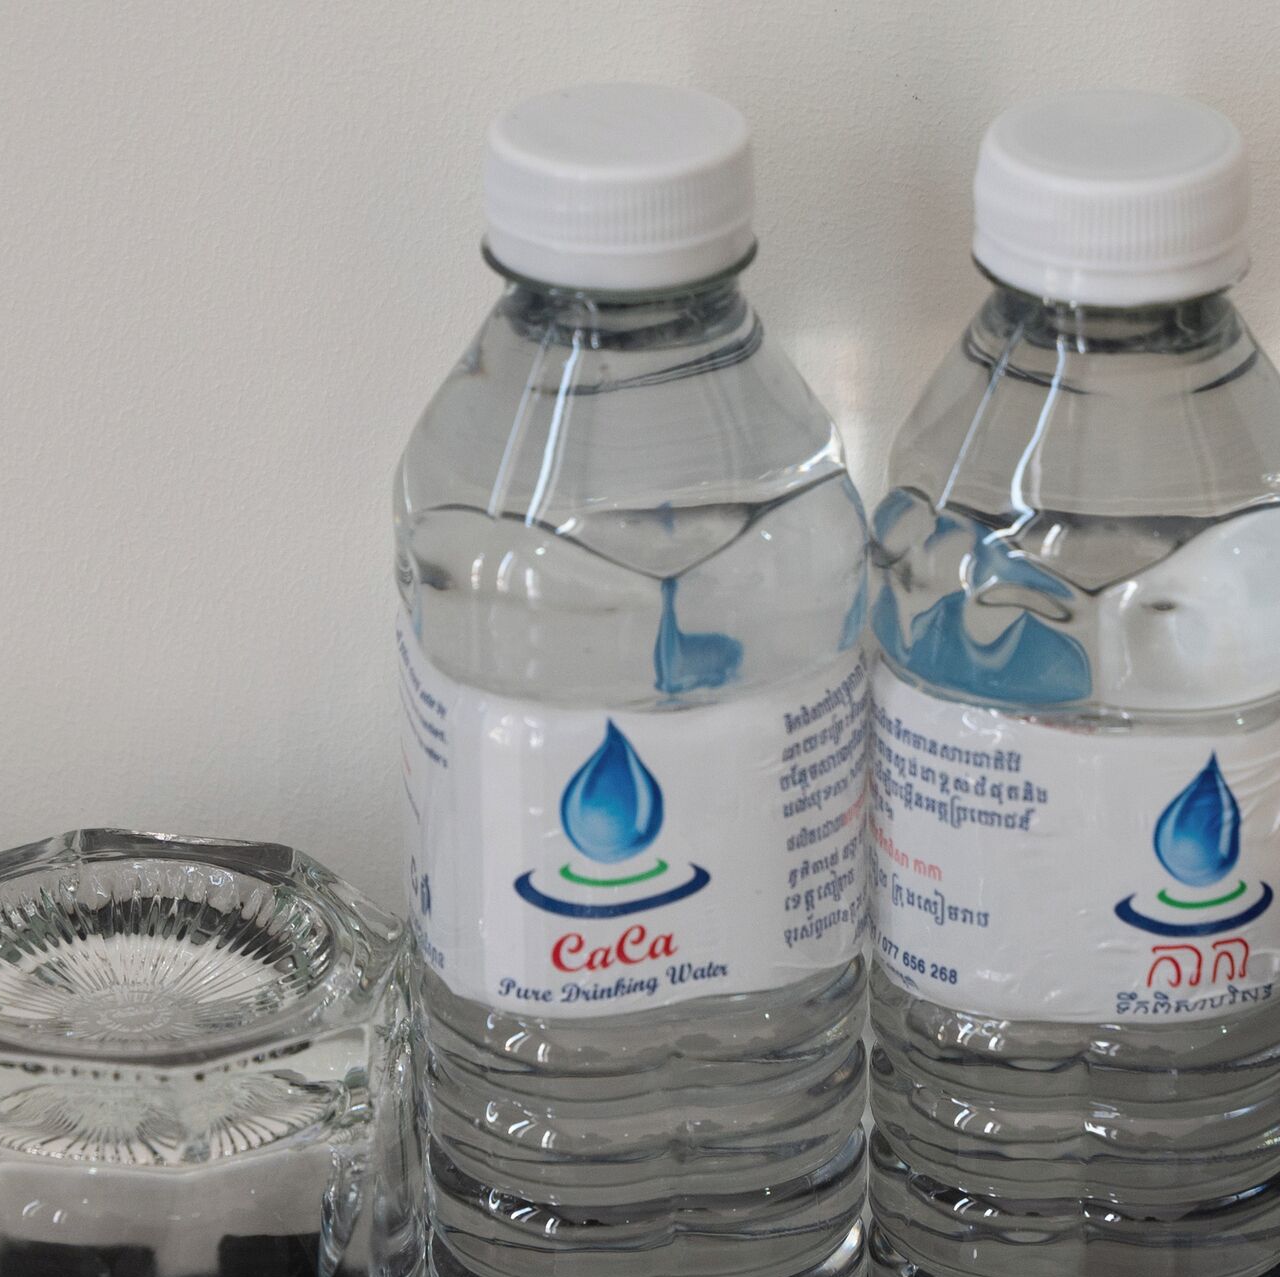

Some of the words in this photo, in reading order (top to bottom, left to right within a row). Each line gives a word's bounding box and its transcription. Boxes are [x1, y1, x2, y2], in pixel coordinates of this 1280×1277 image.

[550, 924, 679, 974] CaCa
[881, 936, 900, 960] 077
[902, 951, 926, 975] 656
[930, 963, 958, 985] 268
[1146, 937, 1252, 988] កាកា
[497, 976, 555, 1004] Pure
[559, 976, 661, 1004] Drinking
[665, 960, 730, 987] Water
